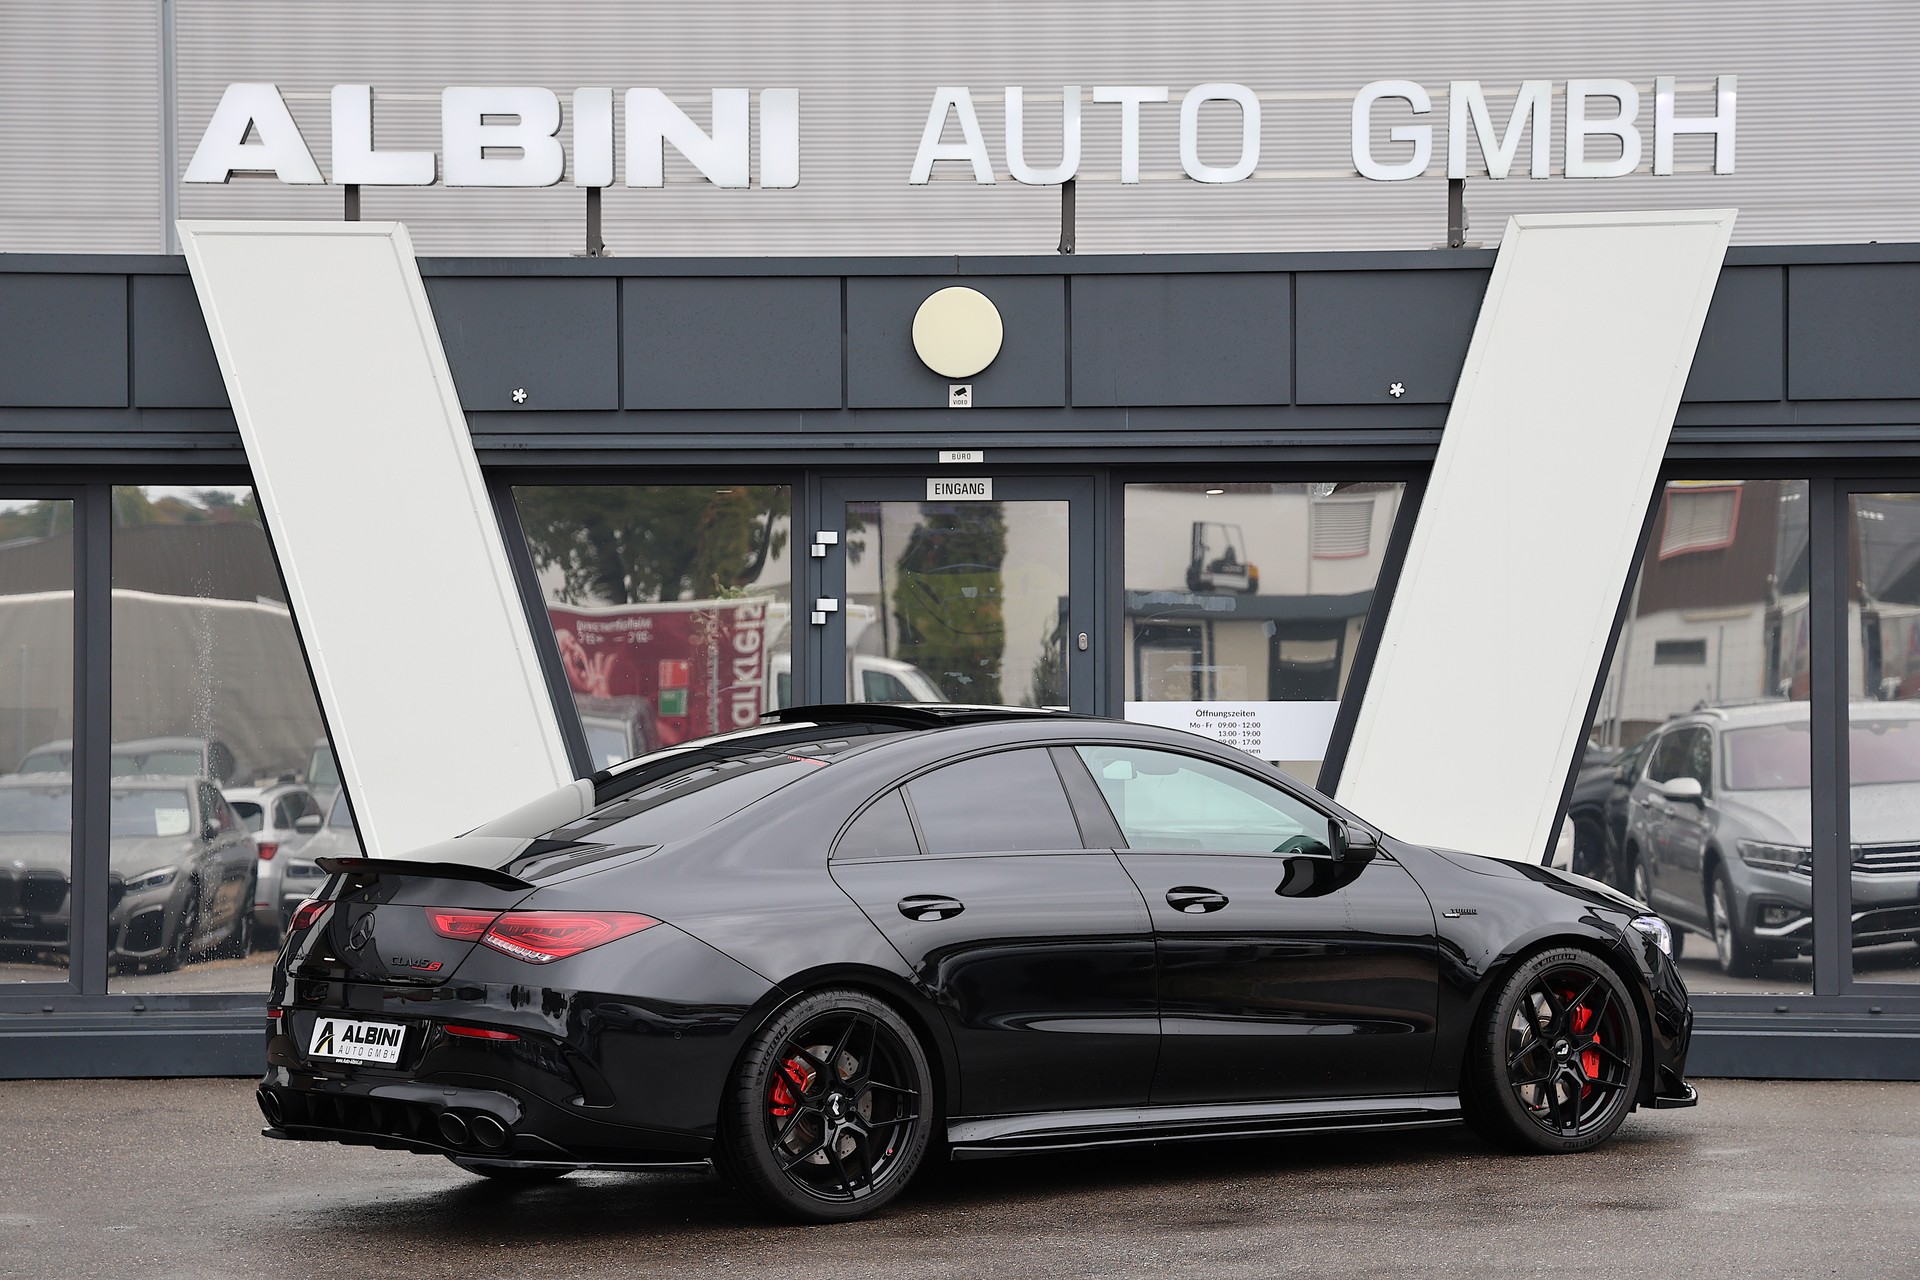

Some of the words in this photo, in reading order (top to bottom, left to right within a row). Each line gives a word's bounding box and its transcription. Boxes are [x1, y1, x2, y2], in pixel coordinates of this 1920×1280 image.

[182, 82, 801, 189] ALBINI
[909, 82, 1261, 186] AUTO
[1350, 74, 1738, 181] GMBH
[952, 452, 971, 460] BÜRO
[935, 483, 985, 495] EINGANG
[1195, 709, 1256, 718] Öffnungszeiten
[1541, 953, 1576, 965] MICHELIN
[341, 1025, 401, 1047] ALBINI
[338, 1045, 364, 1056] AUTO
[367, 1048, 396, 1059] GMBH
[759, 1025, 788, 1073] MICHELIN
